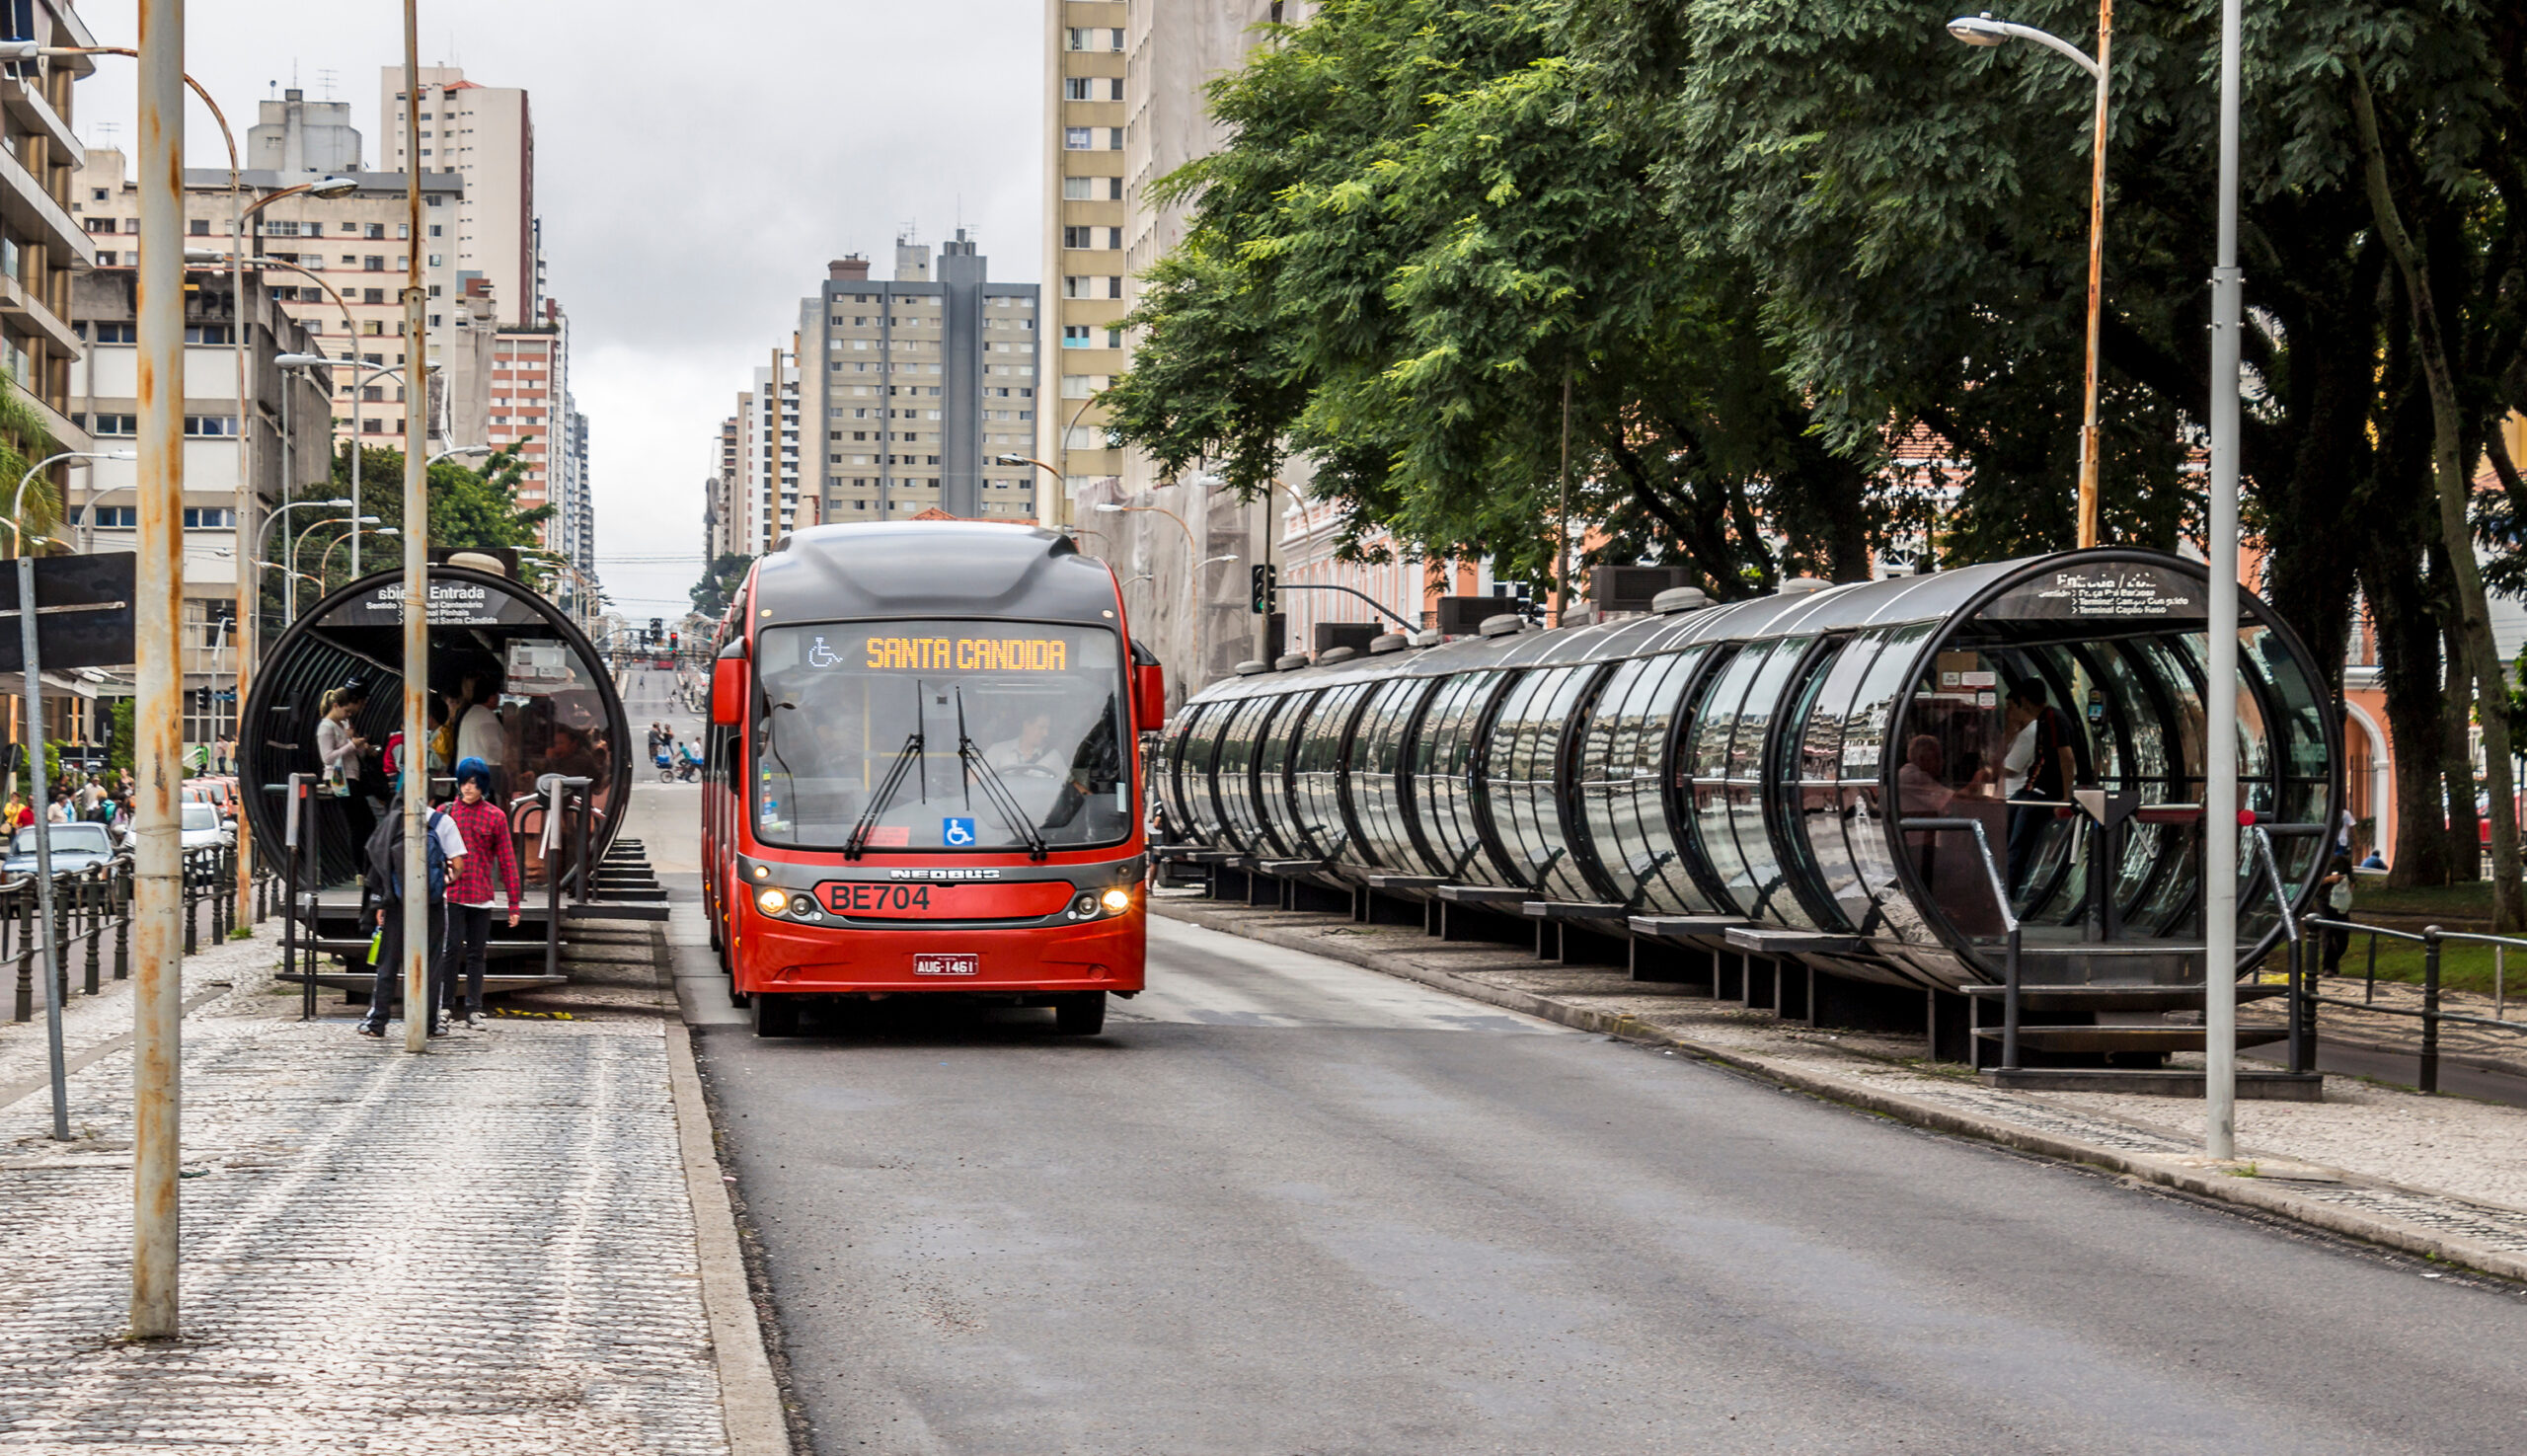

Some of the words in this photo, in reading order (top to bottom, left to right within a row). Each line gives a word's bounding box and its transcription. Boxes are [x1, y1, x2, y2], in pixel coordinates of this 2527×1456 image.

[429, 586, 485, 599] Entrada
[867, 638, 951, 668] SANTA
[957, 639, 1066, 670] CANDIDA
[889, 870, 1000, 880] NEOBUS
[831, 885, 930, 910] BE704
[917, 960, 973, 973] AUG-1461
